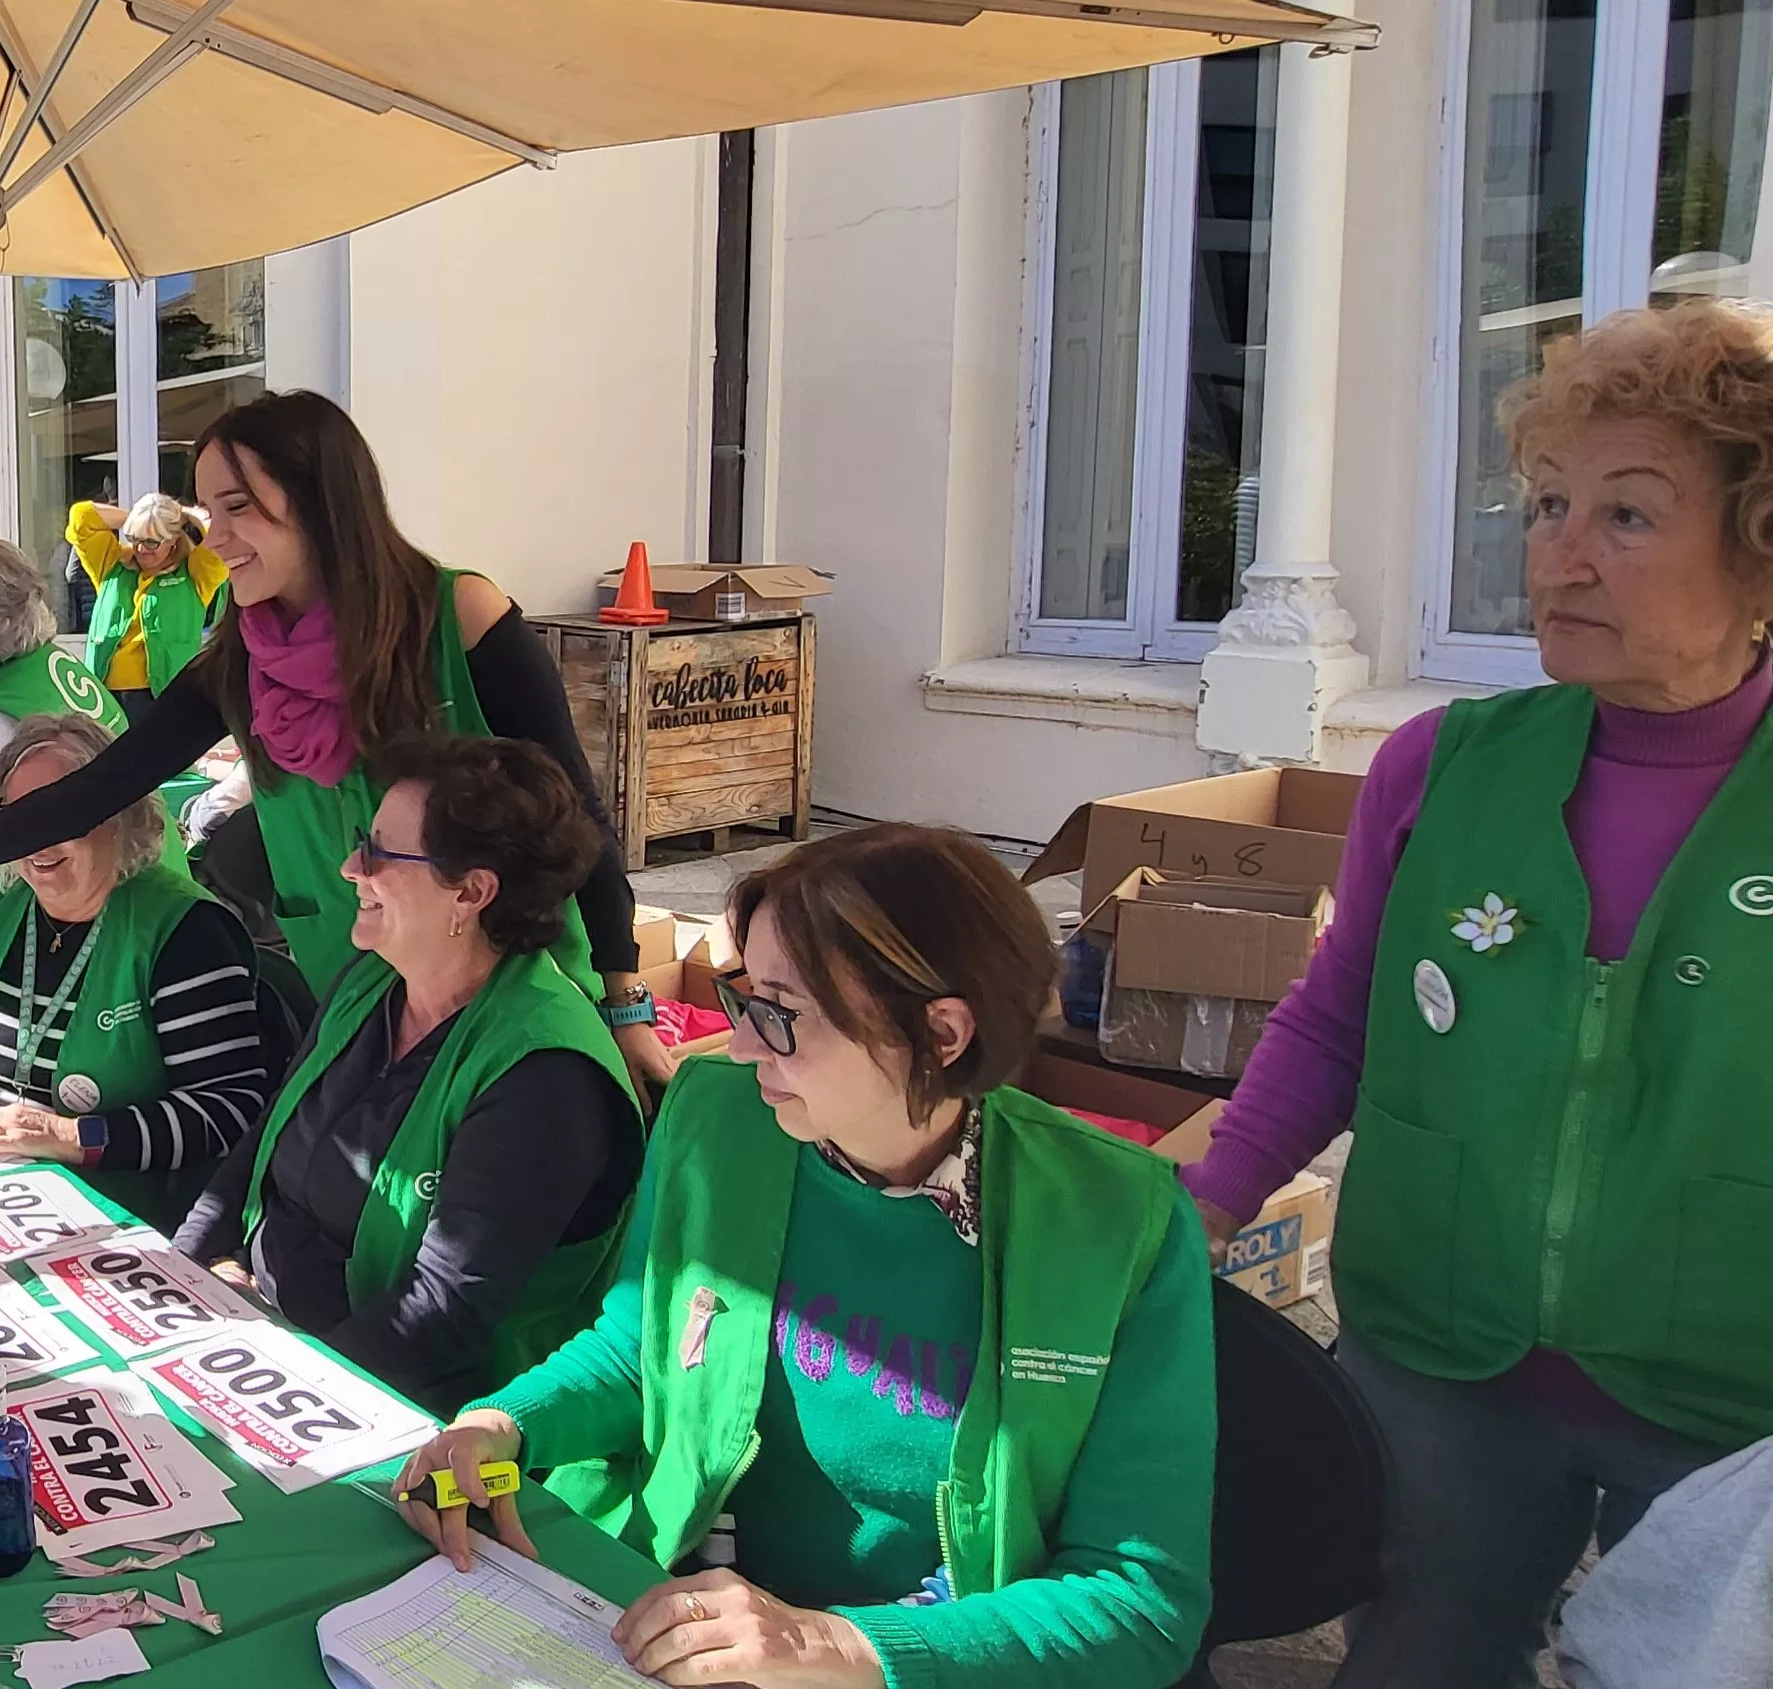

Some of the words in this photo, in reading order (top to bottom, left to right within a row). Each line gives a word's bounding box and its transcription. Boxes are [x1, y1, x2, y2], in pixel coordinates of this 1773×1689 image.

[652, 663, 739, 709] cabecita
[744, 656, 788, 701] loca
[1140, 823, 1166, 866] 4
[1234, 842, 1267, 876] 8
[1226, 1226, 1293, 1269] ROLY
[91, 1253, 214, 1330] 2550
[199, 1348, 361, 1442] 2500
[34, 1396, 161, 1516] 2454
[237, 1411, 299, 1454] CONTRA
[33, 1457, 47, 1475] EL
[40, 1468, 78, 1522] CONTRA
